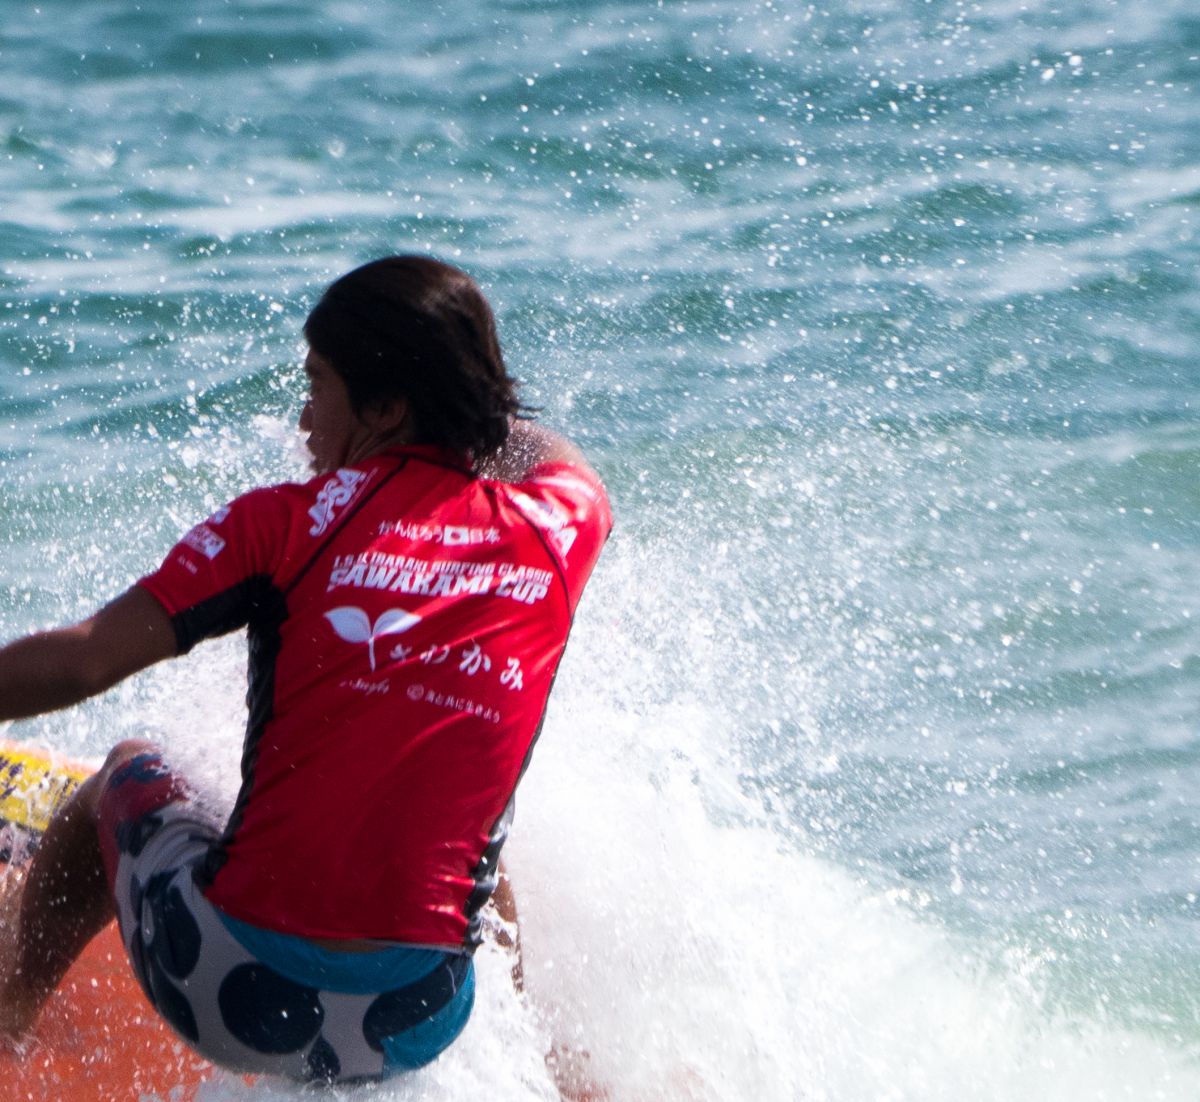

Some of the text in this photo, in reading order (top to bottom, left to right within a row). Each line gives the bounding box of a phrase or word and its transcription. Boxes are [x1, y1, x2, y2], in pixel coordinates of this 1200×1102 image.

[307, 467, 367, 537] JPSA
[495, 574, 549, 605] CUP
[498, 562, 554, 586] CLASSIC
